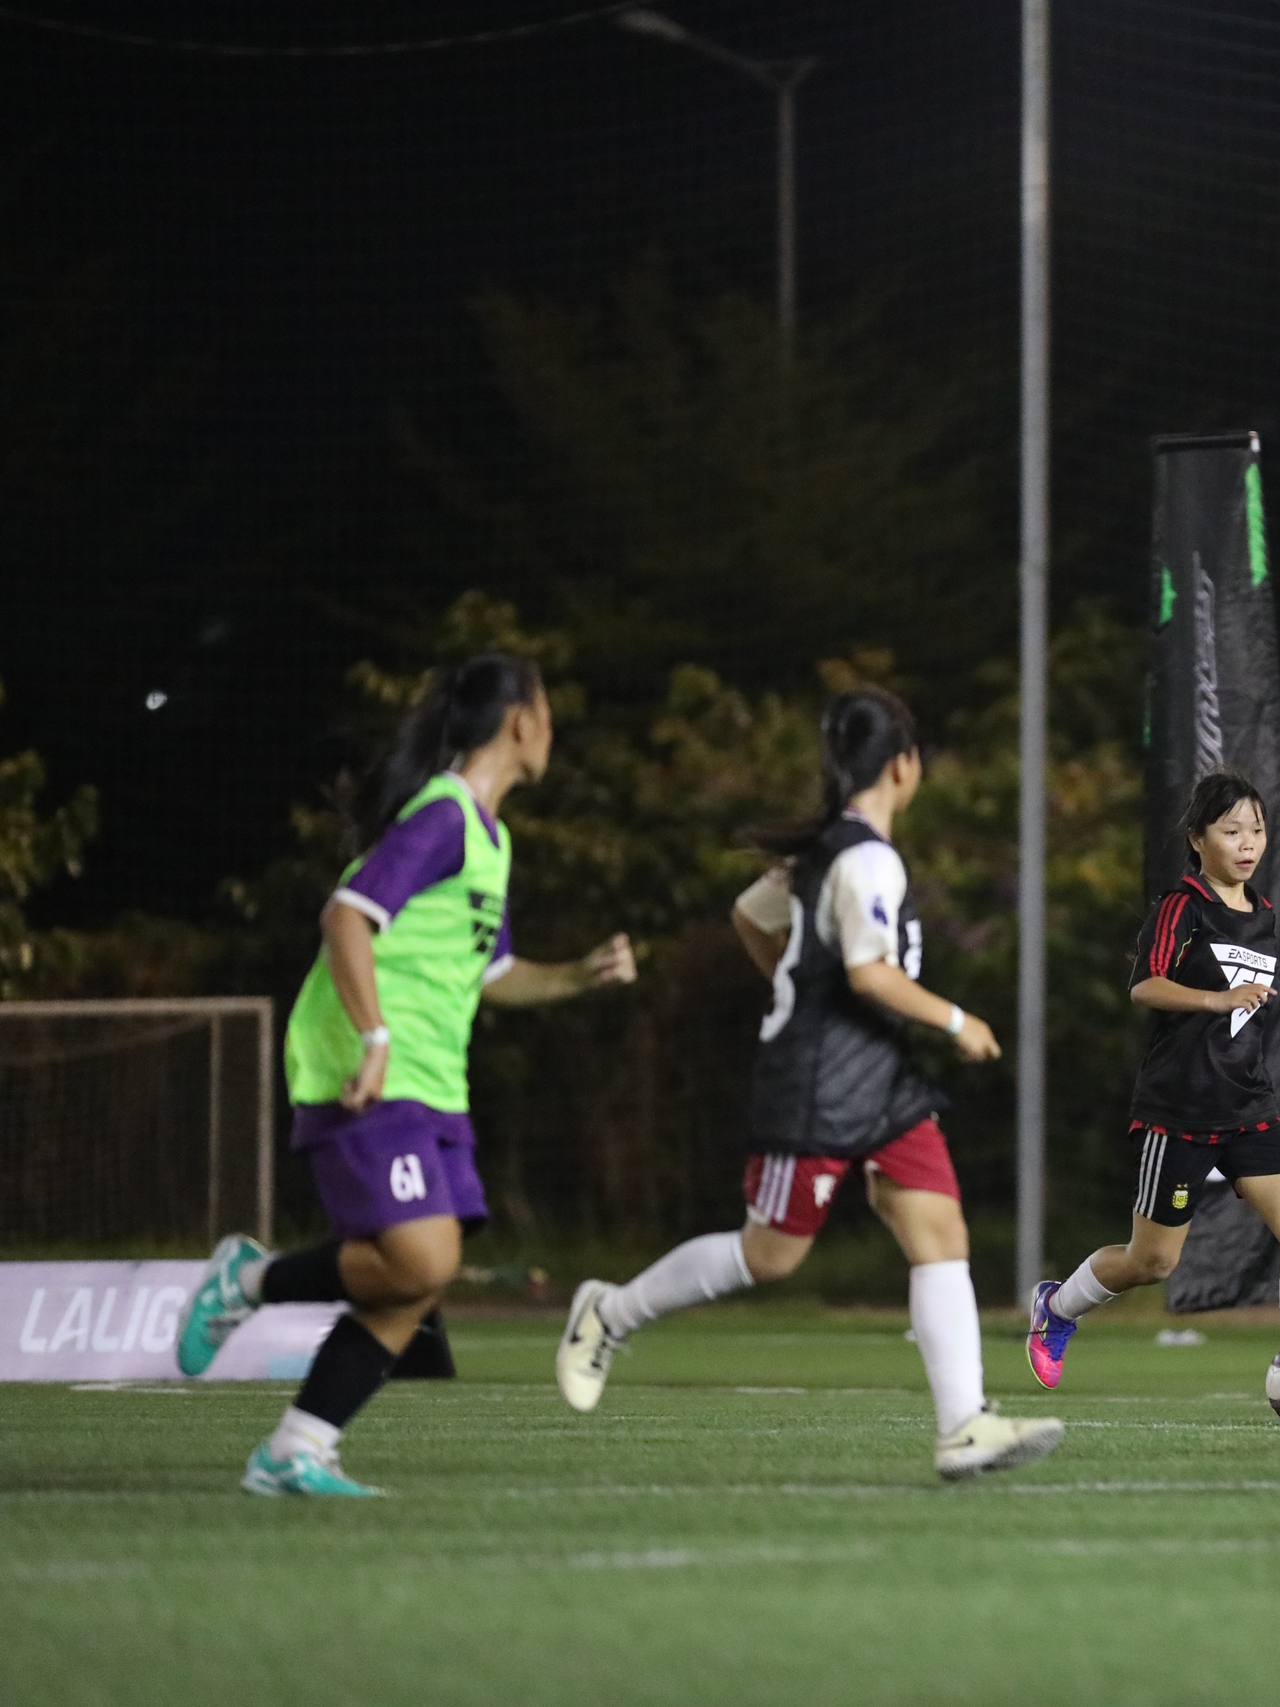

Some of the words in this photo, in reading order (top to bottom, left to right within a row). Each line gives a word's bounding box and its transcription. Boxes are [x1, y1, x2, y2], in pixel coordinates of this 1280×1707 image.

[1228, 948, 1242, 959] EA
[1242, 951, 1267, 968] SPORTS
[19, 1286, 187, 1353] LALIG
